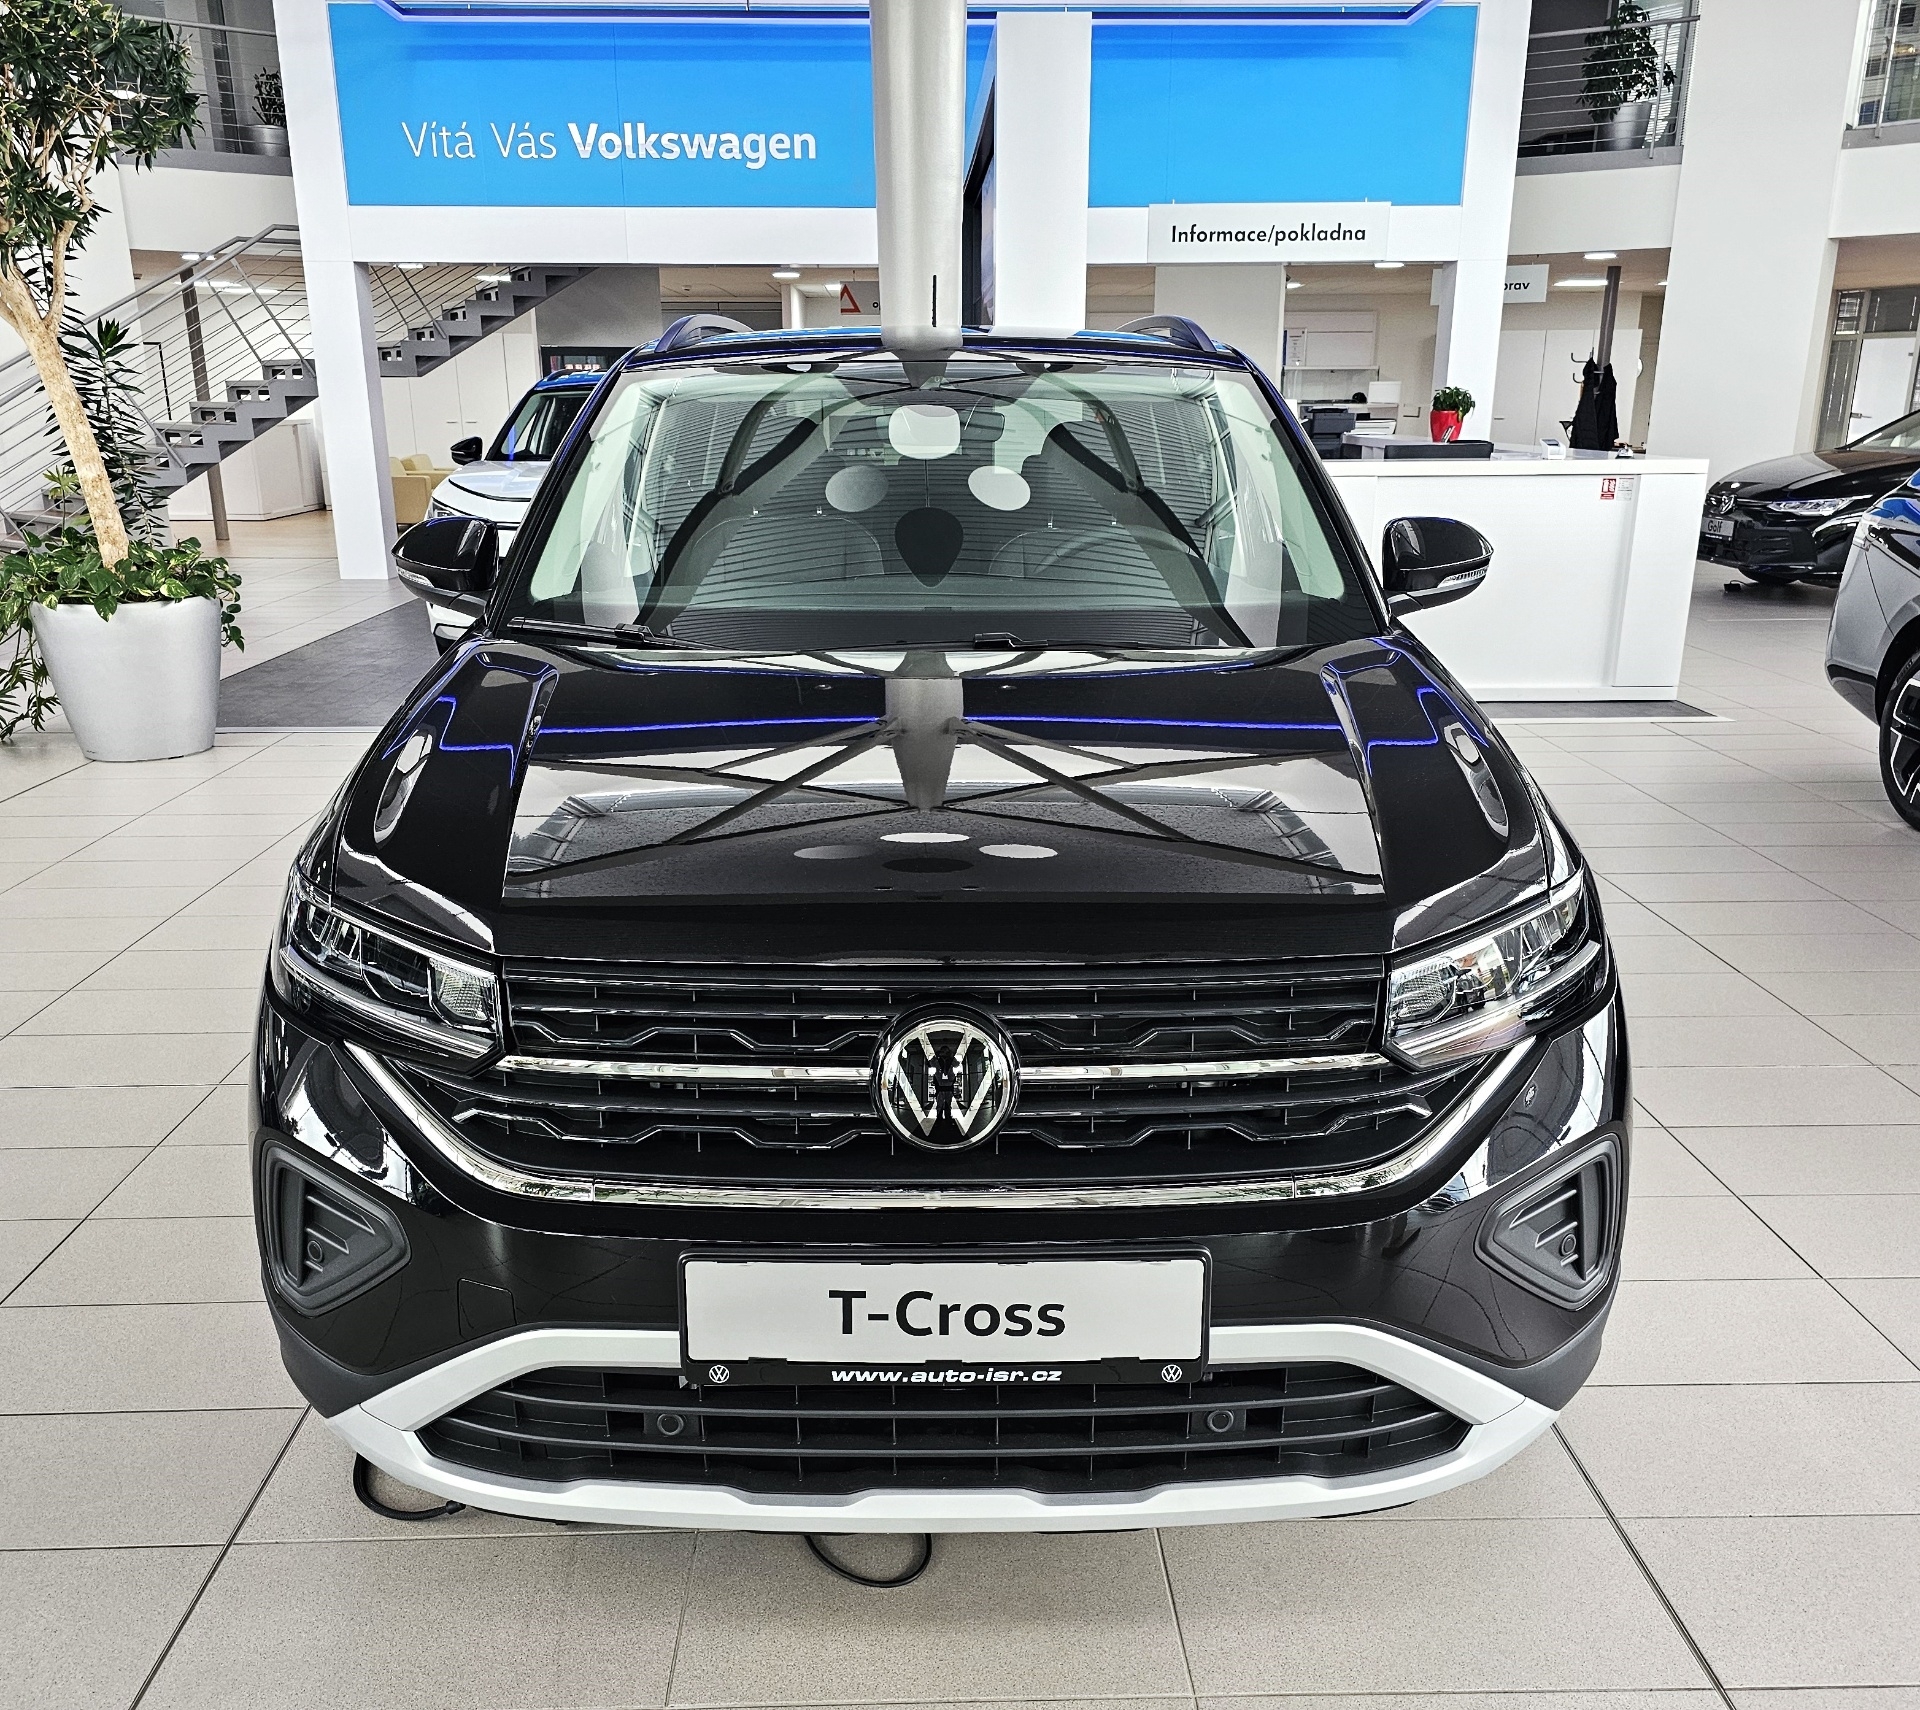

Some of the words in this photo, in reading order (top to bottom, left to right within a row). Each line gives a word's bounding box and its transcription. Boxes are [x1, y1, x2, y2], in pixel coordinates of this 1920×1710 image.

[401, 121, 476, 159] Vítá
[490, 122, 557, 159] Vás
[567, 122, 817, 170] Volkswagen
[1171, 222, 1366, 247] Informace/pokladna
[828, 1289, 1066, 1337] T-Cross
[831, 1367, 1062, 1383] www.auto-isr.cz
